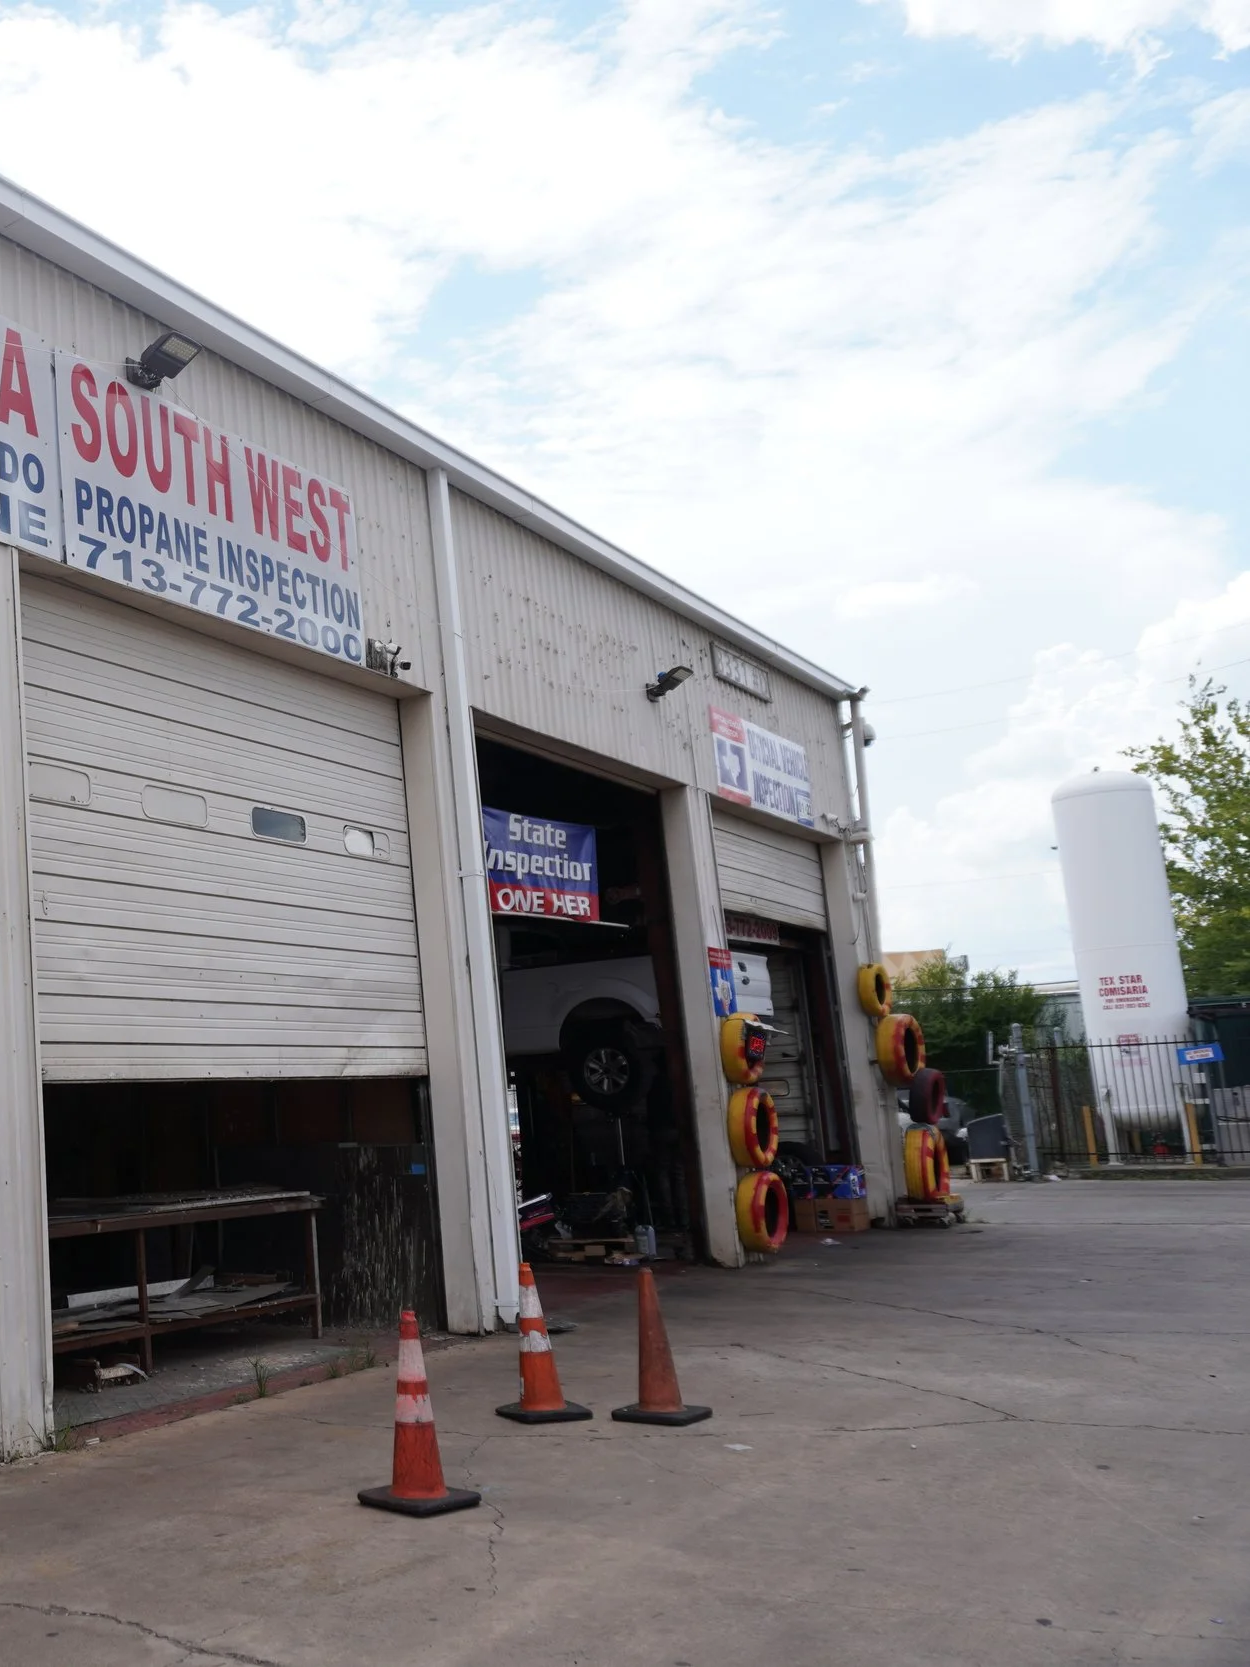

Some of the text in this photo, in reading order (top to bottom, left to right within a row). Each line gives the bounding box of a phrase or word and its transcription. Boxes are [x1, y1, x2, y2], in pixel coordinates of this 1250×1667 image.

[71, 363, 351, 572] SOUTH WEST
[74, 477, 361, 631] PROPANE INSPECTION
[78, 534, 362, 663] 713-772-2000
[509, 813, 567, 849] State
[1099, 974, 1143, 986] TEX STAR
[1099, 985, 1149, 997] COMISARIA
